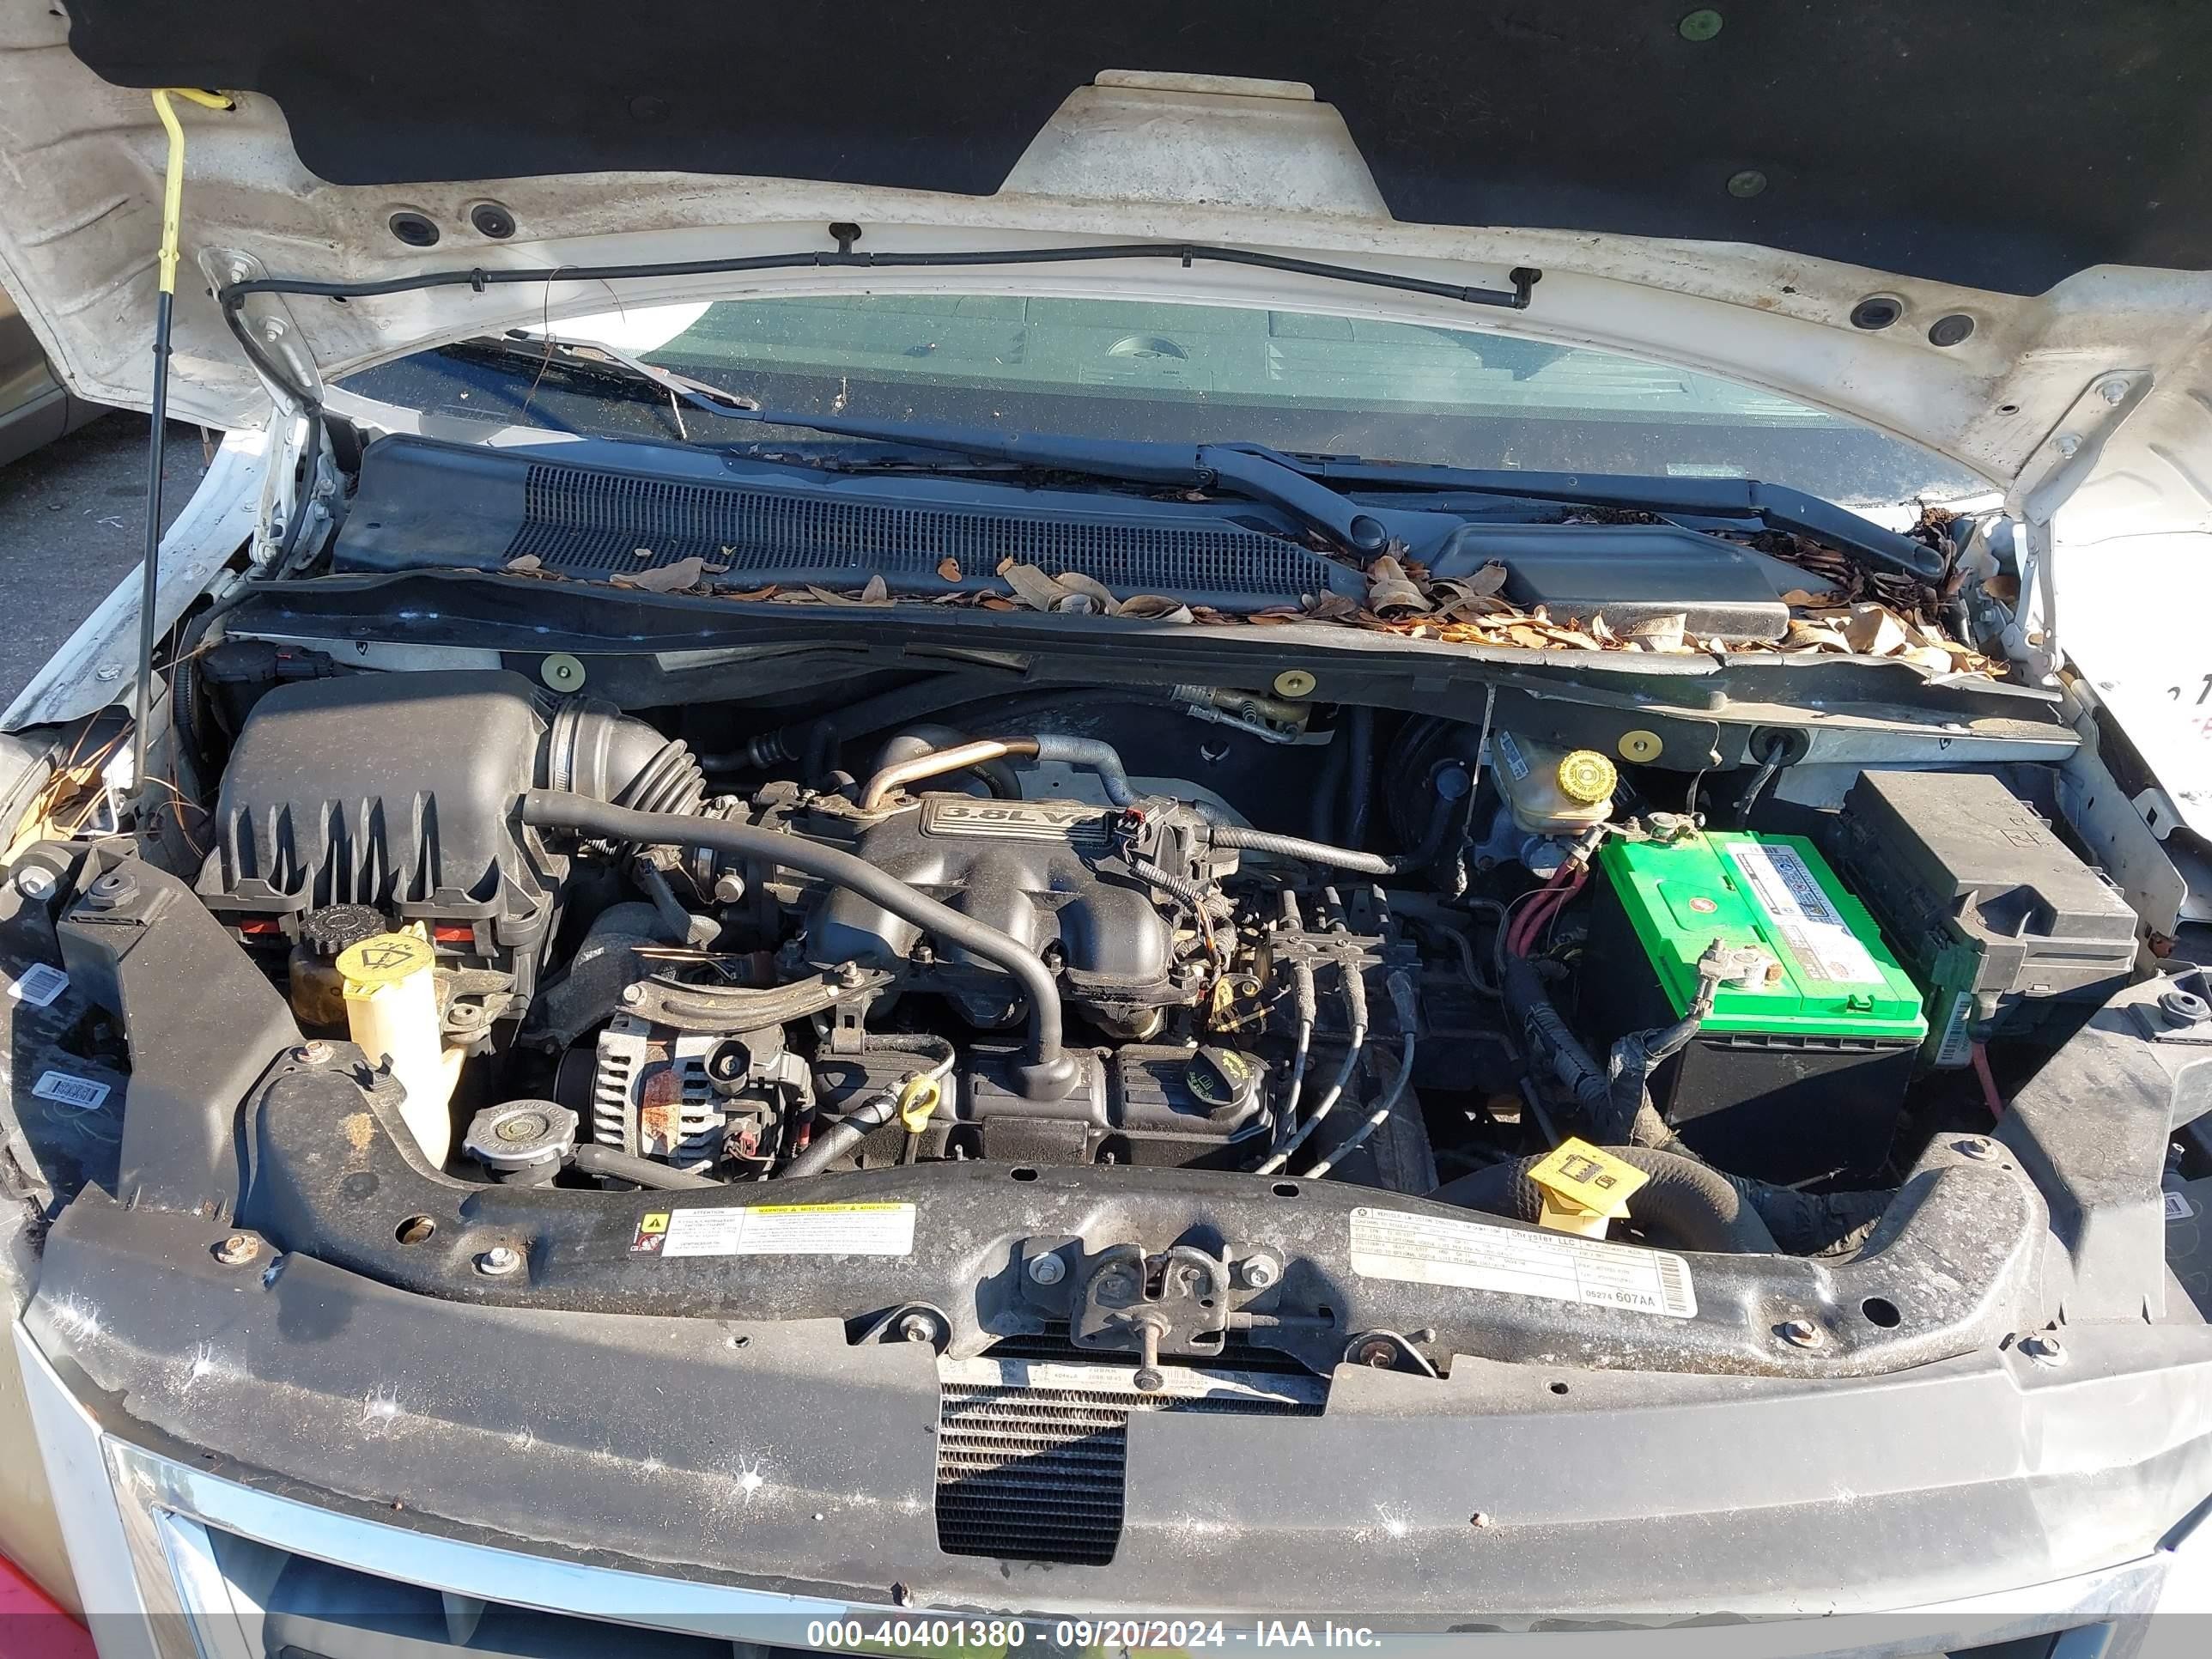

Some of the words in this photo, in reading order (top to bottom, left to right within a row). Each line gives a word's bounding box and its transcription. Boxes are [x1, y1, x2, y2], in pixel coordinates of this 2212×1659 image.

[943, 807, 1036, 822] 3.8L
[1223, 1050, 1246, 1070] ENGINE
[1188, 1071, 1198, 1084] SAE
[1511, 1231, 1553, 1244] Chrysler
[1558, 1235, 1576, 1246] LLC
[1585, 1290, 1613, 1301] 05274
[1615, 1291, 1656, 1307] 607AA
